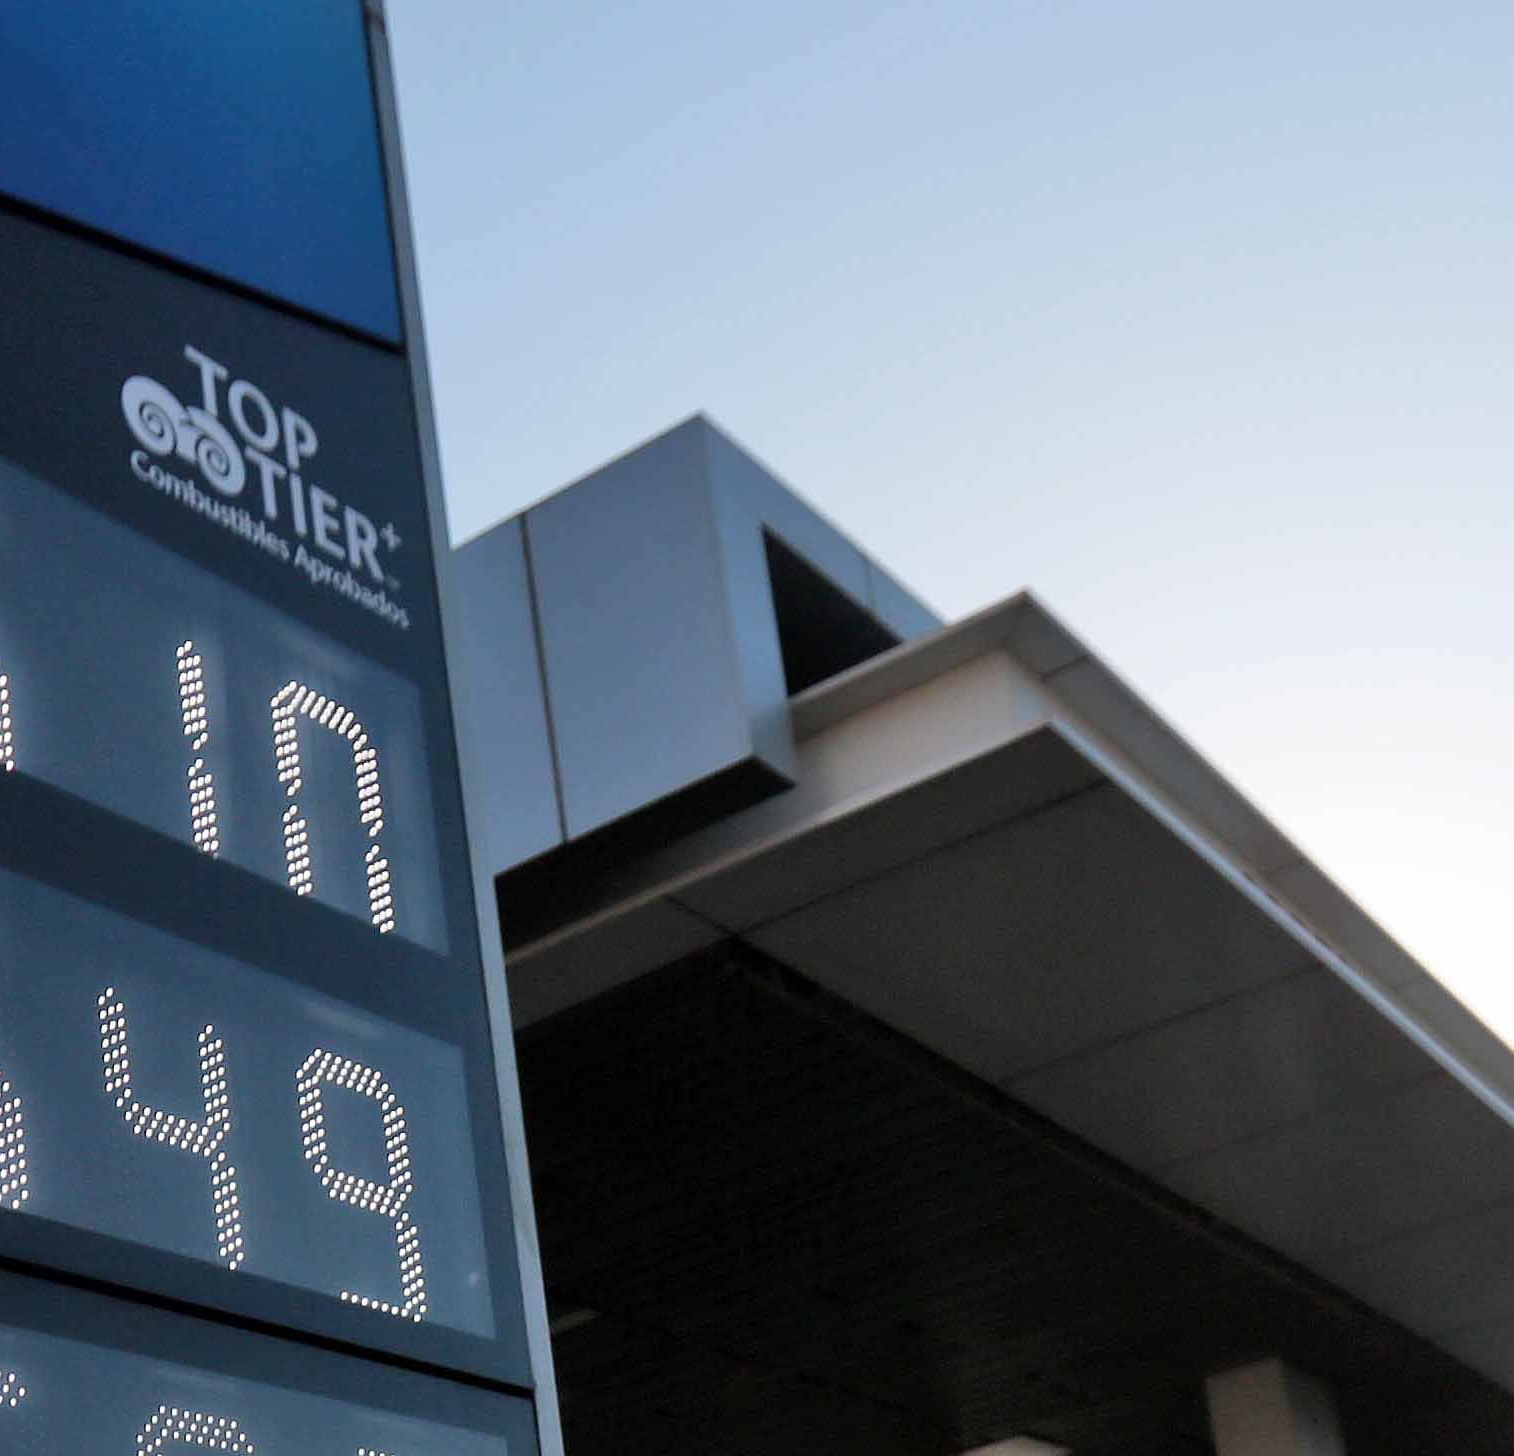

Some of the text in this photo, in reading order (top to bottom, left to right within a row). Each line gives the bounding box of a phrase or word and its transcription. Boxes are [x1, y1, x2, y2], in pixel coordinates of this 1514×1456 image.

[184, 344, 319, 471] TOP
[130, 450, 410, 631] Combustibles Aprobados
